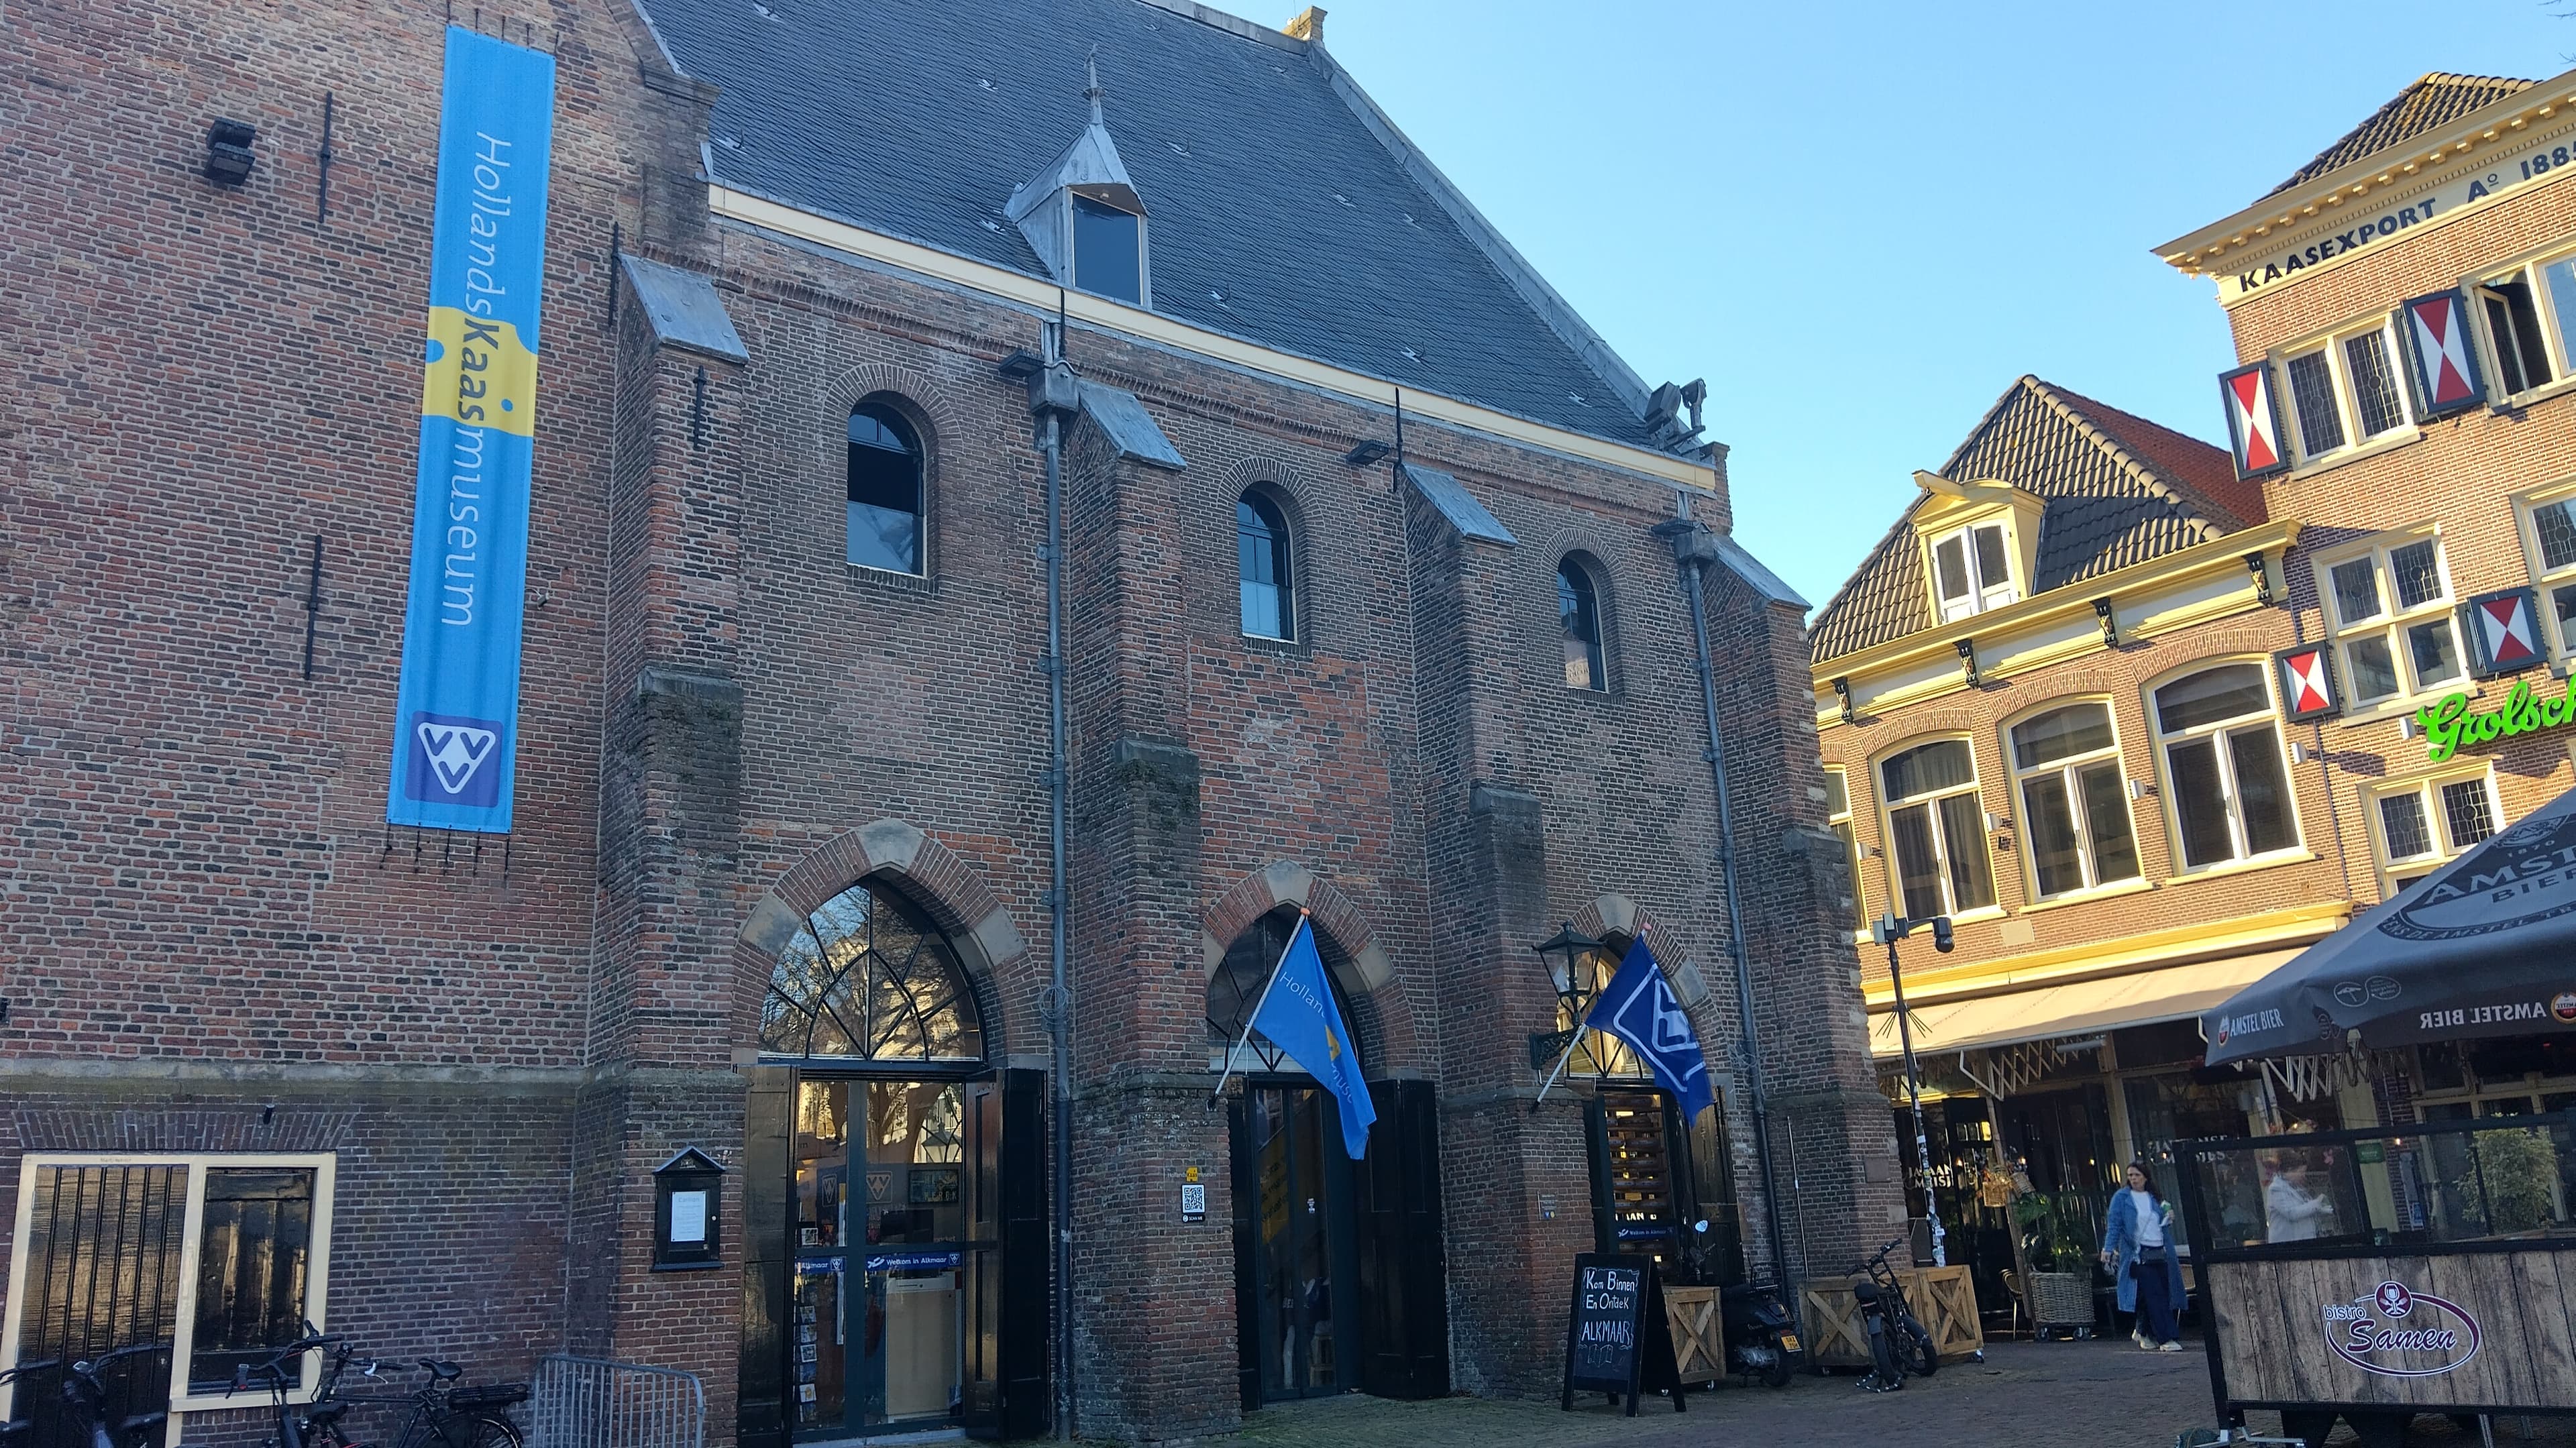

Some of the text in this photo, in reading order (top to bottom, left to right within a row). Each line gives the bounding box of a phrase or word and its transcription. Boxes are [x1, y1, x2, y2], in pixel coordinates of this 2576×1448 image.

[2239, 197, 2436, 292] KAASEXPORT
[2520, 141, 2576, 181] 188
[2230, 1008, 2284, 1037] AMSTEL BIER
[1586, 1270, 1635, 1292] Kom Binnen
[1586, 1294, 1597, 1310] En
[2323, 1304, 2367, 1321] bistro
[1581, 1320, 1630, 1345] ALKMAAR
[2346, 1318, 2457, 1353] Samen
